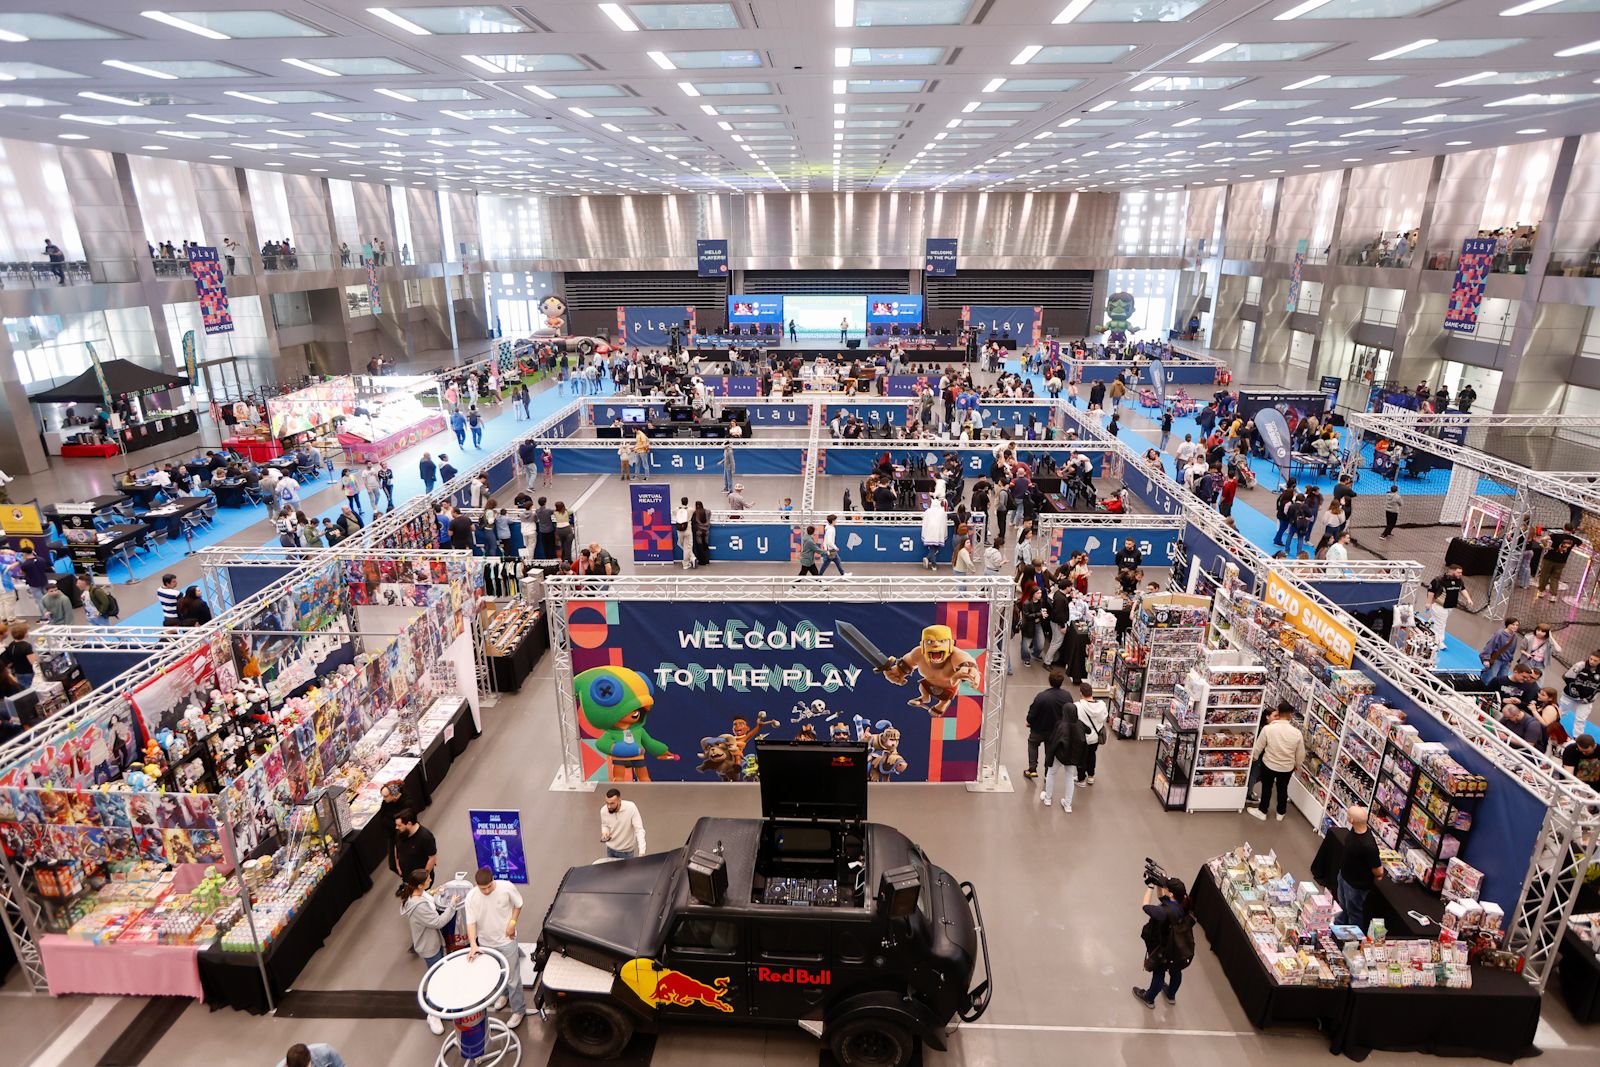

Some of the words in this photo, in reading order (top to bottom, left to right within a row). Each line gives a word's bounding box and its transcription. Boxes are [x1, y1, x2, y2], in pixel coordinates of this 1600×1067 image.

[205, 323, 233, 333] GAME-FEST
[1444, 321, 1476, 330] GAME-FEST
[1268, 582, 1299, 616] GOLD
[1301, 608, 1352, 660] SAUCER
[678, 630, 834, 649] WELCOME
[654, 668, 694, 687] TO
[705, 669, 770, 687] THE
[783, 668, 863, 687] PLAY
[758, 966, 795, 983] Red
[797, 968, 831, 985] Bull
